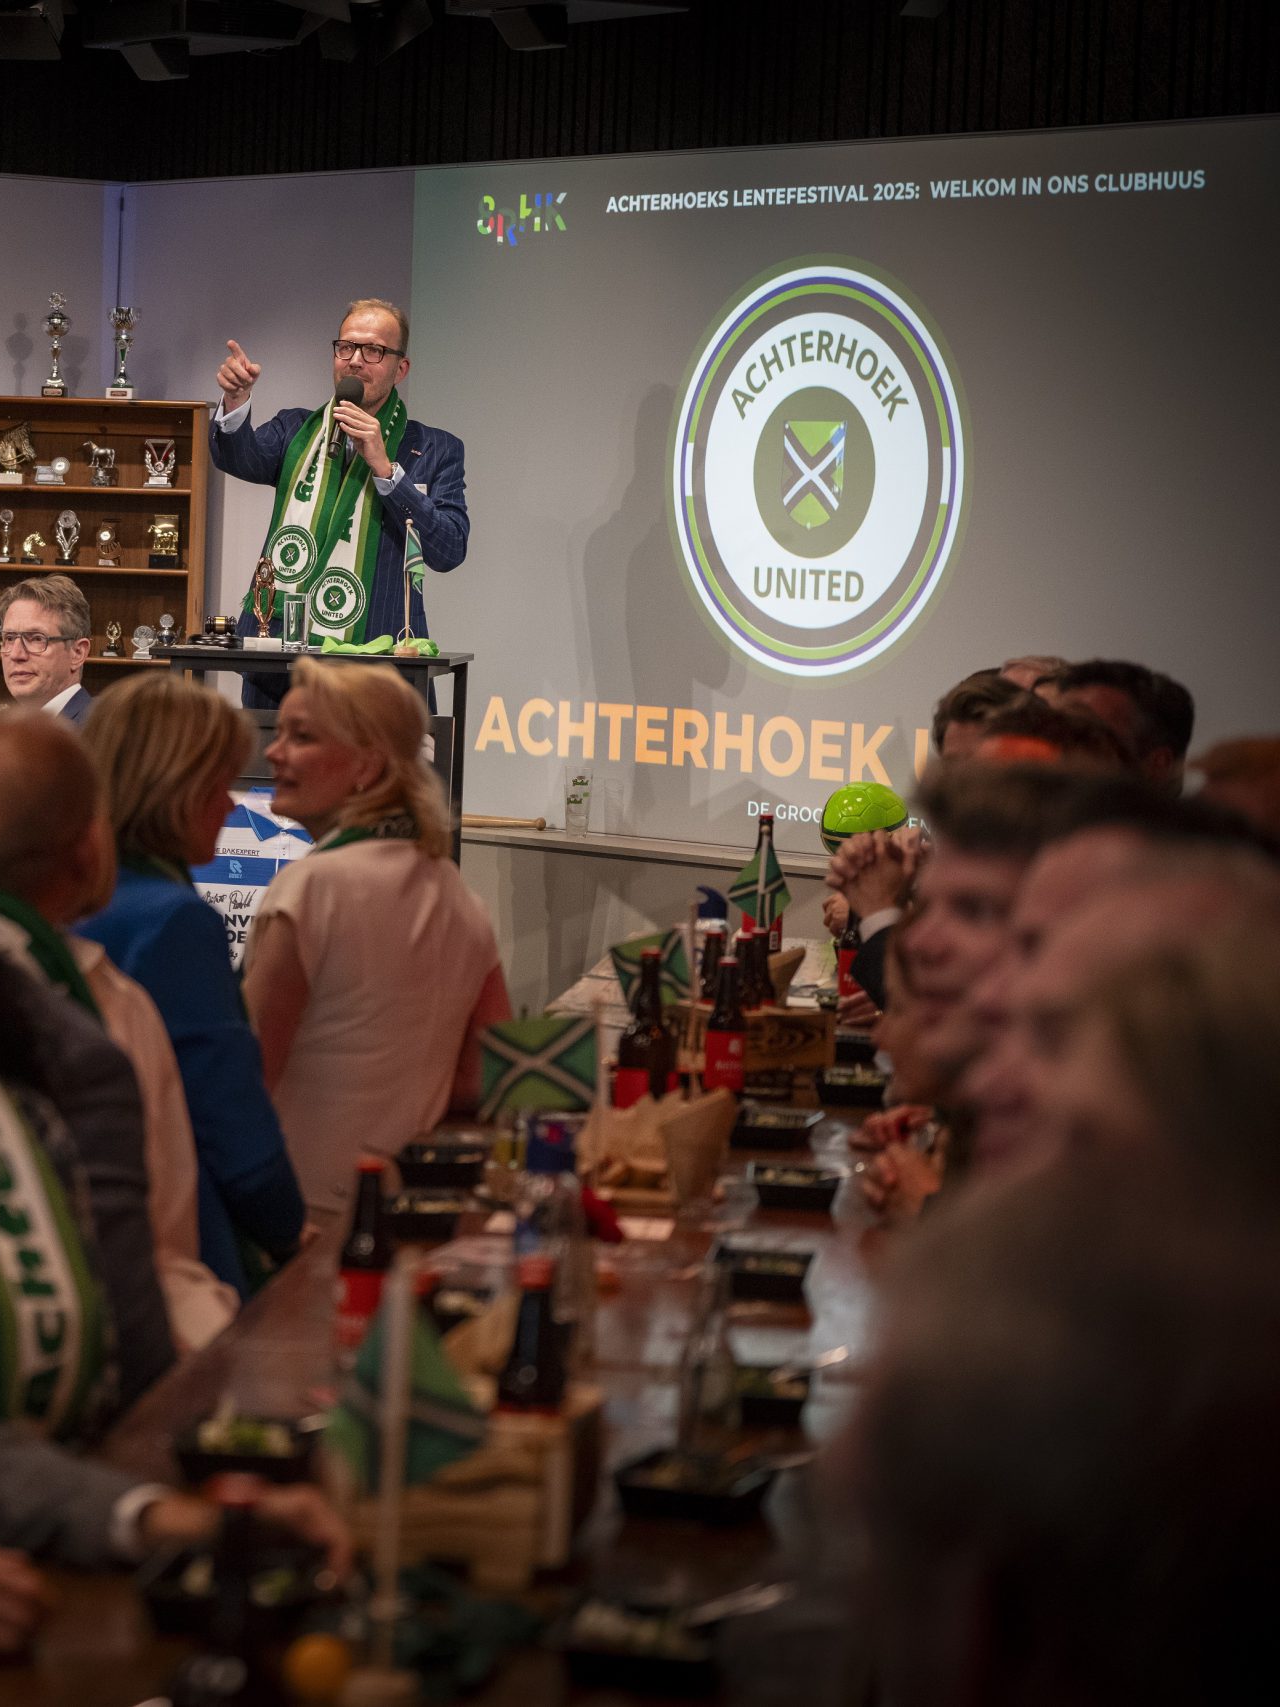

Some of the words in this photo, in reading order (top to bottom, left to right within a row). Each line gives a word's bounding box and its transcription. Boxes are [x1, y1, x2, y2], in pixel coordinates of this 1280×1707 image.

[606, 190, 729, 214] ACHTERHOEKS
[733, 184, 869, 207] LENTEFESTIVAL
[873, 182, 921, 201] 2025:
[930, 177, 1017, 199] WELKOM
[1022, 176, 1042, 196] IN
[1047, 174, 1090, 195] ONS
[1094, 170, 1206, 192] CLUBHUUS
[730, 330, 910, 422] ACHTERHOEK
[753, 566, 865, 602] UNITED
[474, 696, 894, 788] ACHTERHOEK
[222, 848, 260, 856] DAKEXPERT
